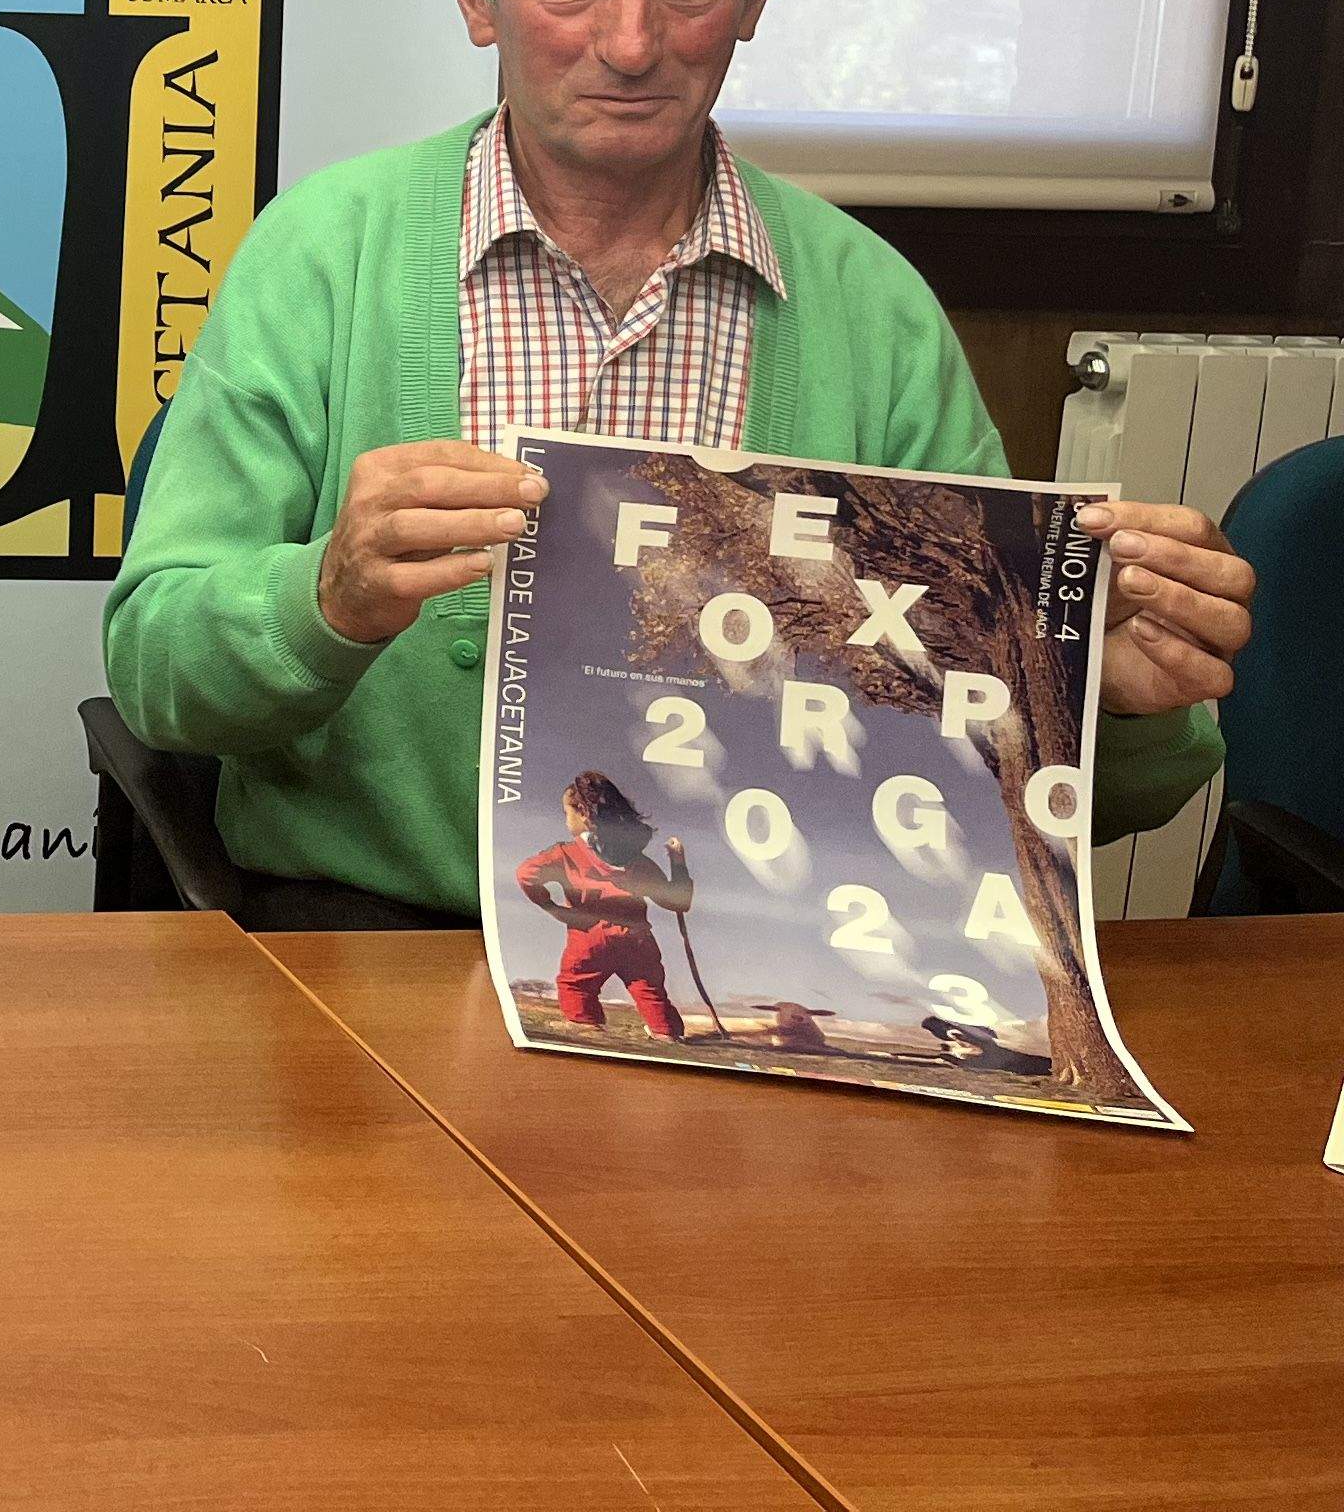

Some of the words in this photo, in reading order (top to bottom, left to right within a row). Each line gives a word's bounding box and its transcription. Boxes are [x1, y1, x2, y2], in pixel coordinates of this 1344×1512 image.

[1045, 500, 1066, 541] PUENTE
[1043, 541, 1056, 557] LA
[508, 570, 535, 605] DE
[1038, 557, 1055, 592] REINA
[1037, 591, 1051, 608] DE
[506, 613, 531, 646] LA
[1035, 608, 1049, 639] JACA
[629, 671, 643, 682] en
[497, 650, 528, 805] JACETANIA
